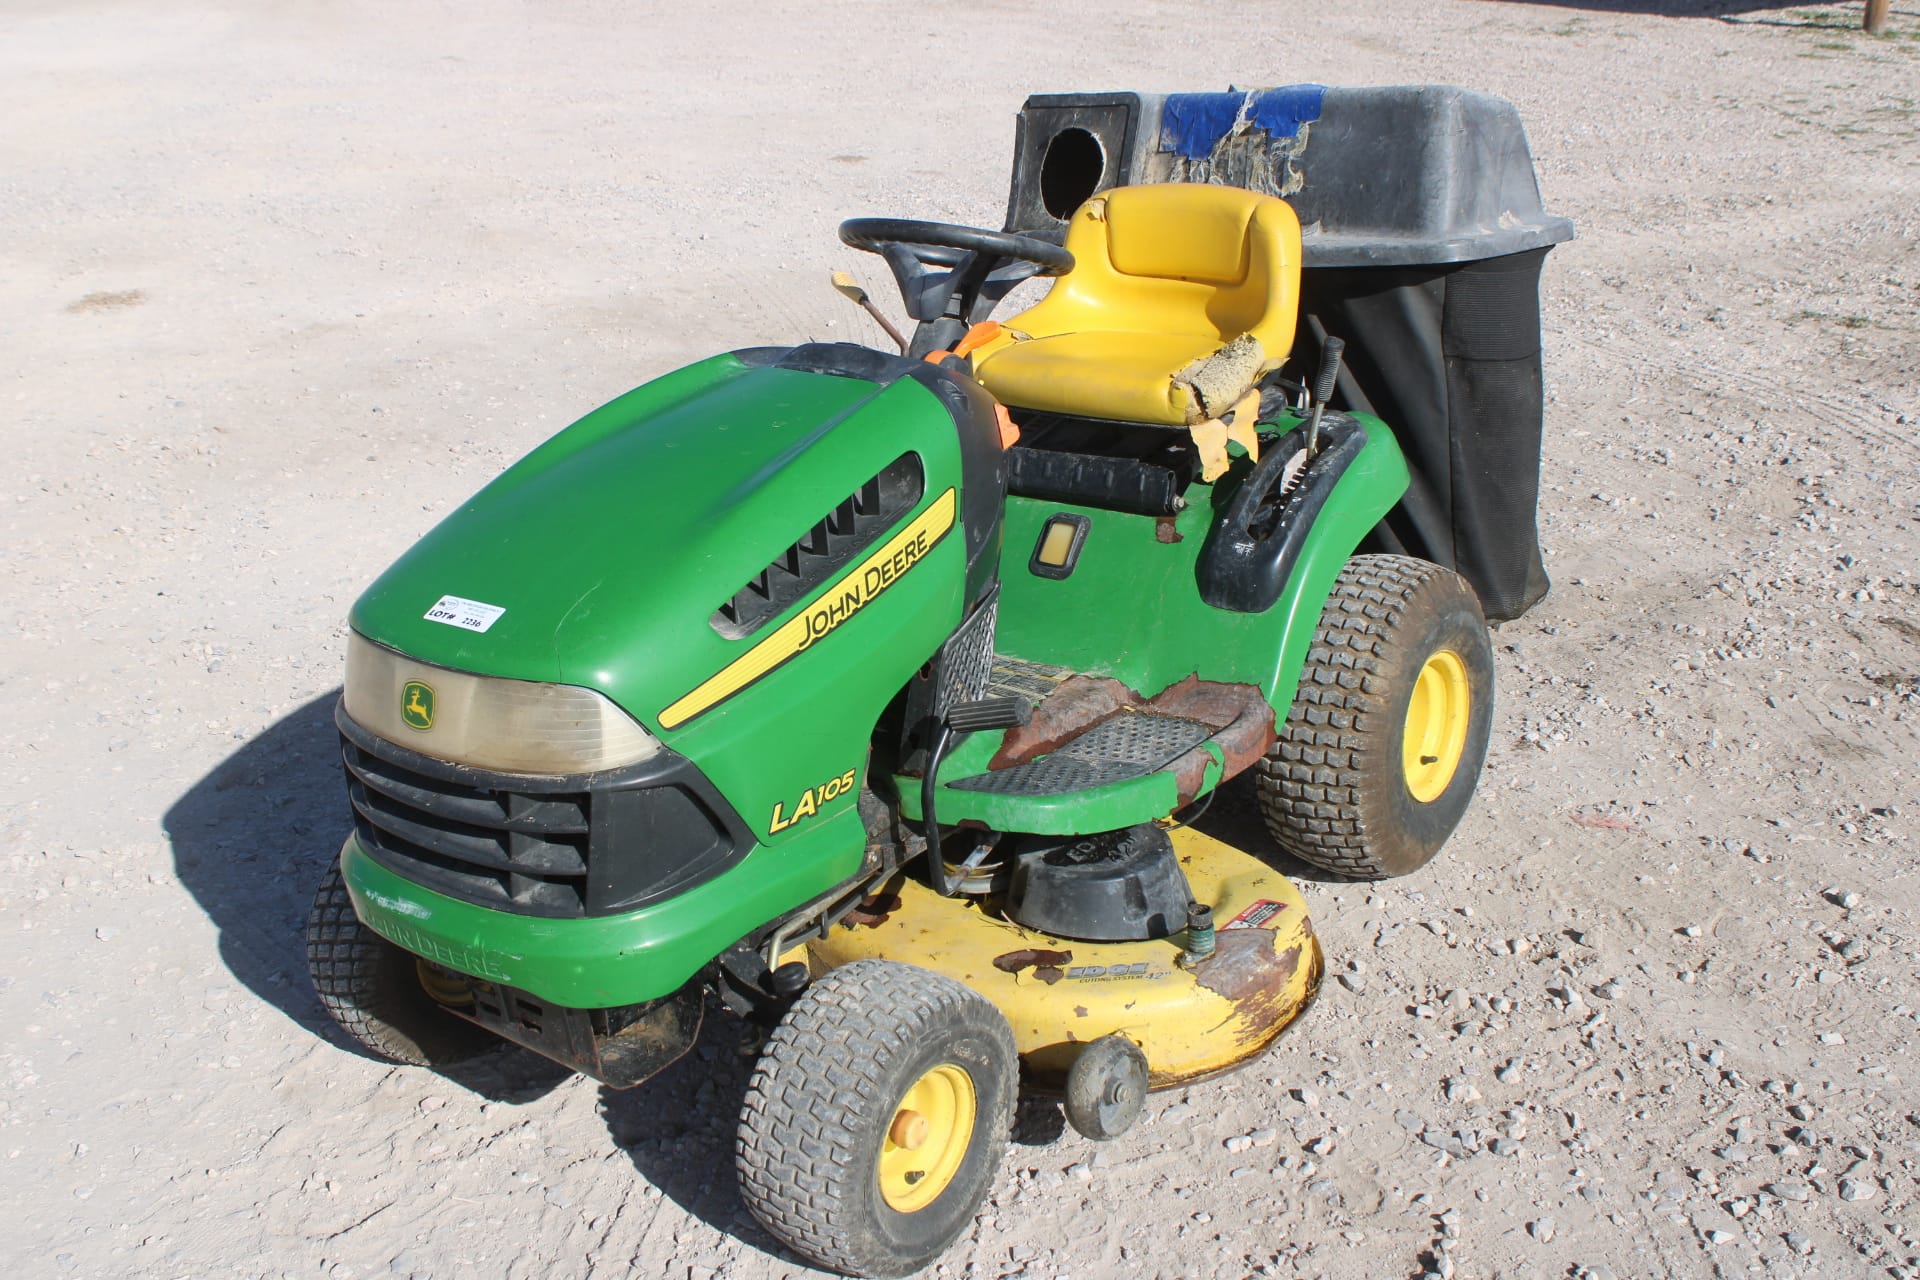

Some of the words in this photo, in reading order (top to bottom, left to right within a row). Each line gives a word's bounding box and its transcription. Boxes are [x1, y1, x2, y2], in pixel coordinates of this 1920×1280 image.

[798, 583, 861, 649] JOHN
[865, 529, 928, 596] DEERE
[428, 609, 456, 620] LOT#
[461, 617, 481, 628] 2236
[768, 767, 856, 836] LA105
[1065, 963, 1149, 979] EDGE
